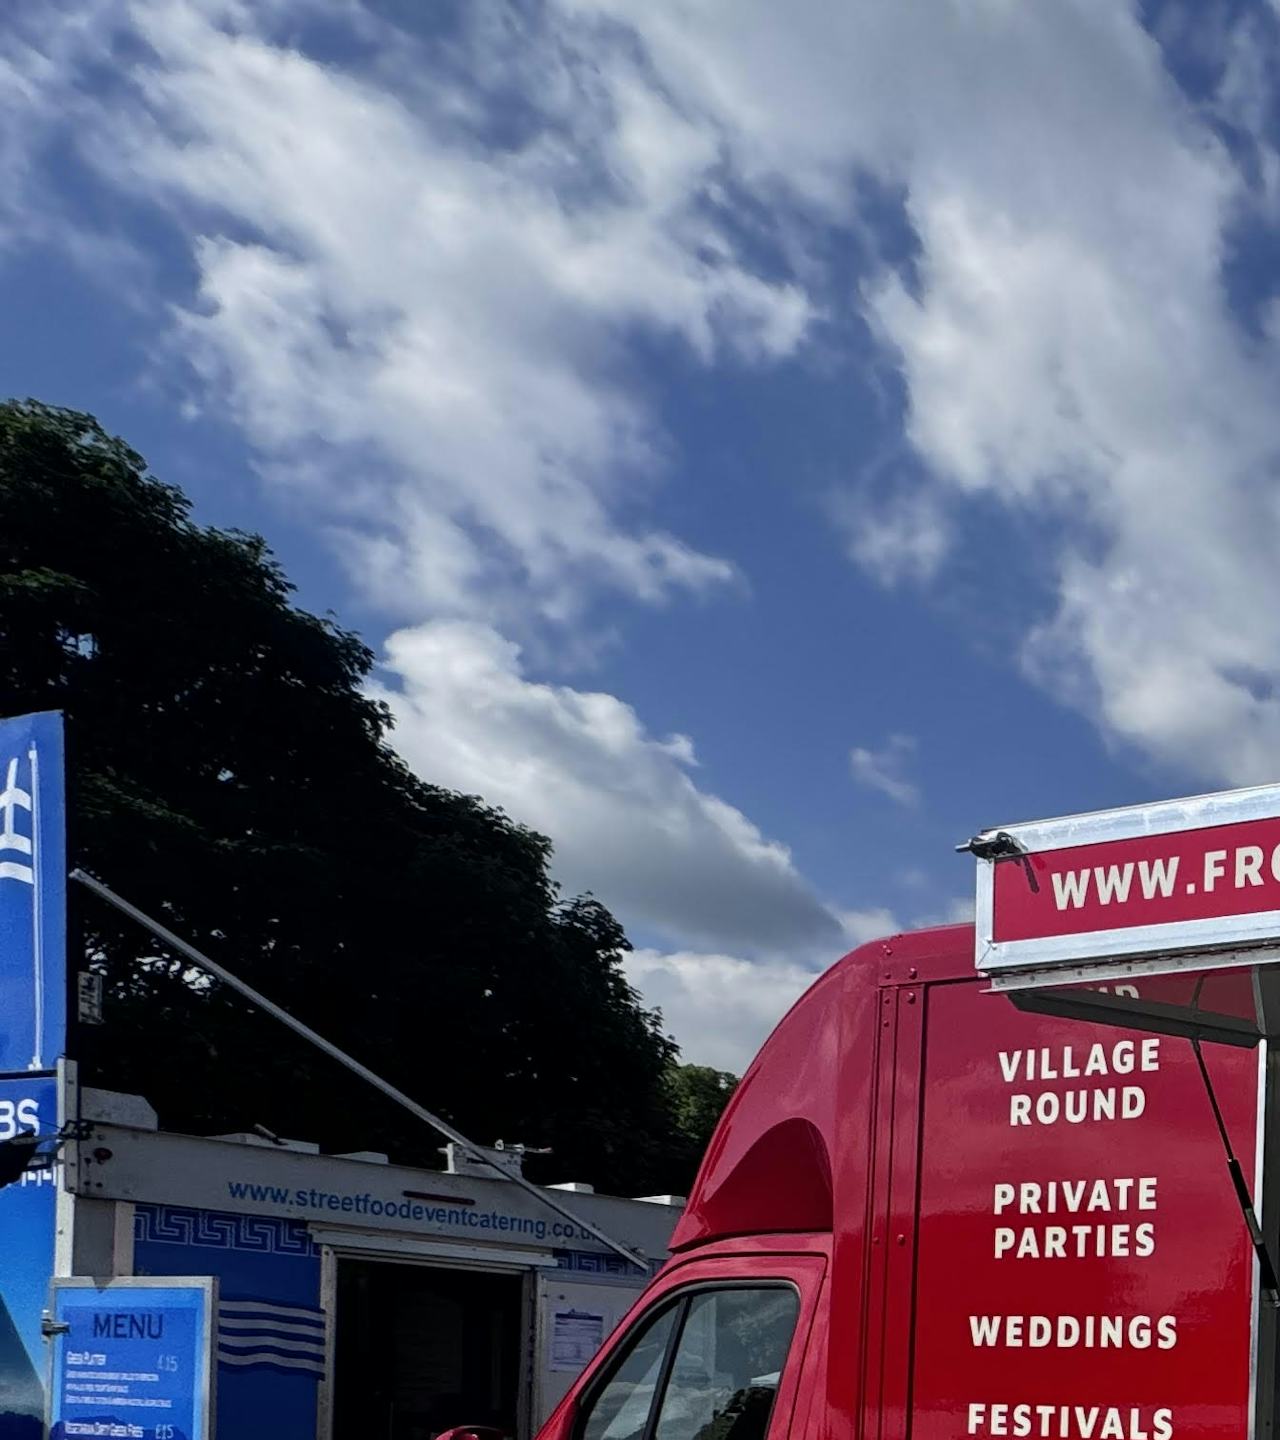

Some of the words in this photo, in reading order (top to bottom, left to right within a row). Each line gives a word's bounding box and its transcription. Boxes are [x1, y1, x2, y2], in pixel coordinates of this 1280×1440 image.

[999, 1038, 1160, 1082] VILLAGE
[1010, 1086, 1146, 1126] ROUND
[993, 1177, 1158, 1215] PRIVATE
[994, 1223, 1155, 1259] PARTIES
[93, 1313, 164, 1341] MENU
[968, 1315, 1178, 1350] WEDDINGS
